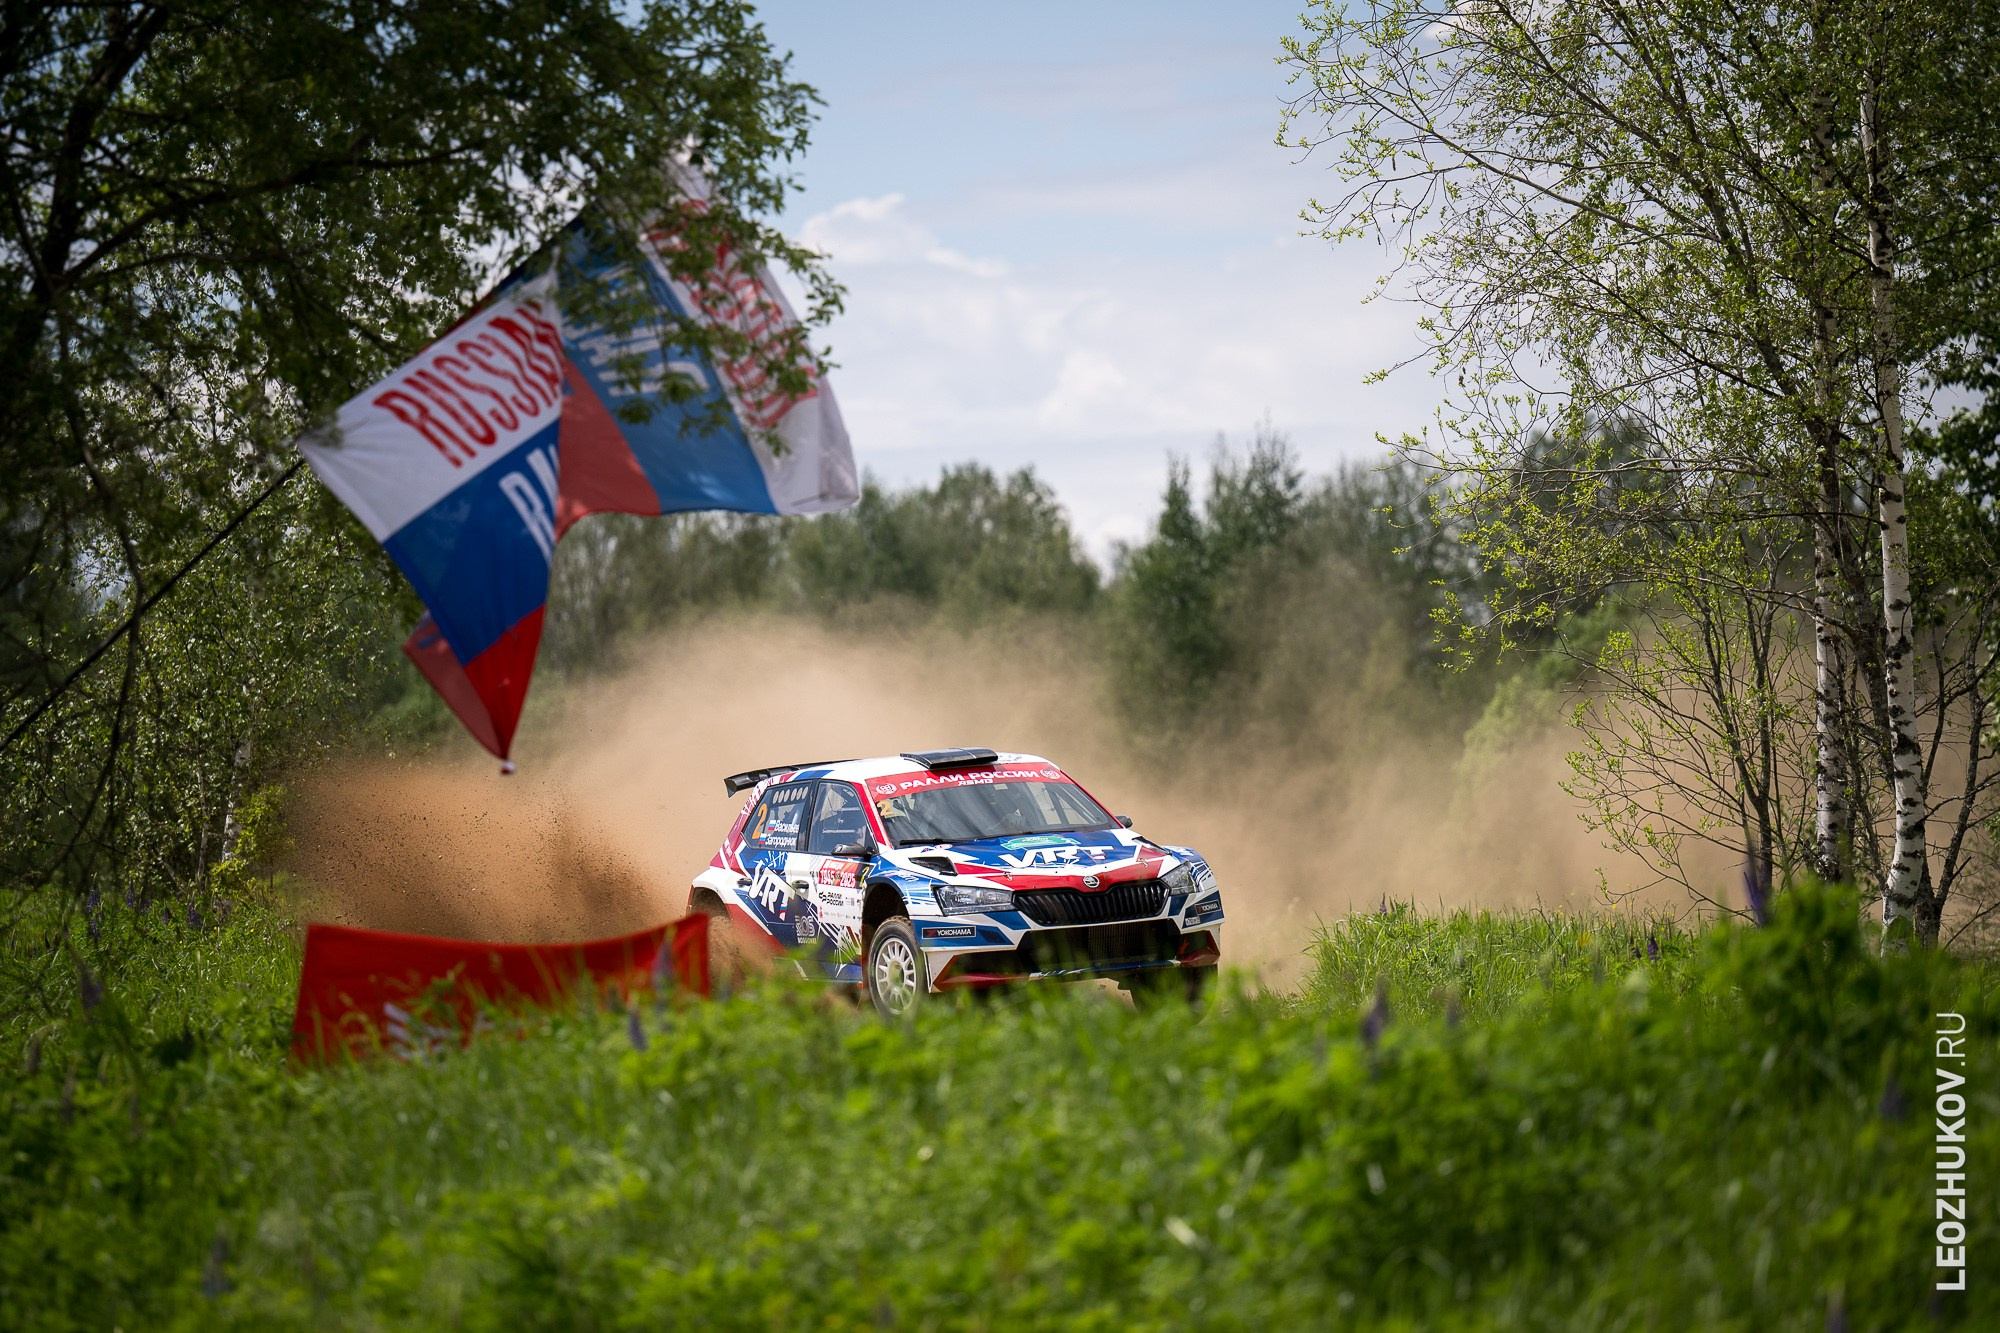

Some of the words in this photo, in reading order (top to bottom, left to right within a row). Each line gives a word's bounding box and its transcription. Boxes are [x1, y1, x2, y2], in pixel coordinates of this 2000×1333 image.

[901, 773, 965, 790] РАЛЛИ
[968, 769, 1039, 781] РОССИИ
[877, 800, 895, 817] 2
[752, 803, 768, 839] 2
[998, 845, 1114, 869] VRT
[749, 860, 797, 921] VRT
[937, 928, 972, 936] YOKOHAMA
